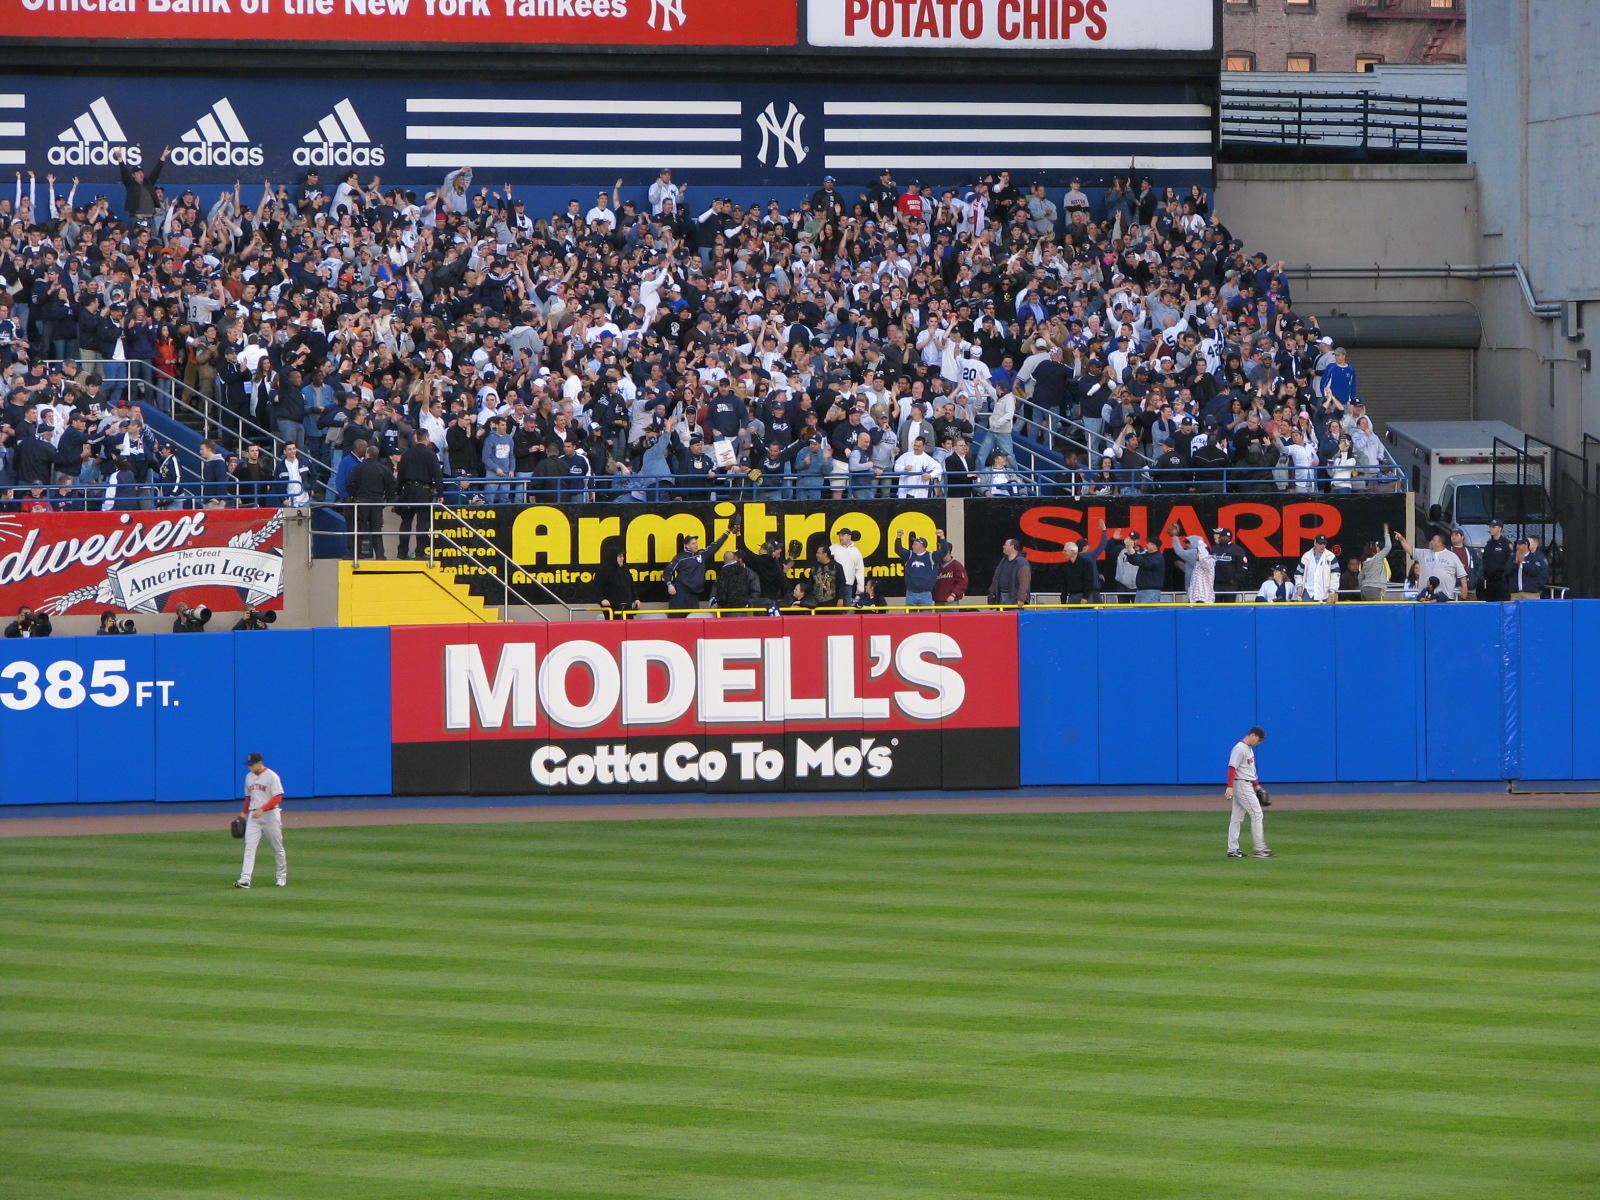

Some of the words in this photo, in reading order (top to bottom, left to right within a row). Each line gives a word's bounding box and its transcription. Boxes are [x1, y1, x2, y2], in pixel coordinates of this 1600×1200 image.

[345, 0, 410, 15] New
[424, 0, 491, 16] York
[503, 0, 628, 18] Yankees
[844, 0, 983, 39] POTATO
[997, 0, 1108, 41] CHIPS
[47, 141, 142, 166] adidas
[170, 141, 264, 166] adidas
[292, 141, 385, 166] adidas
[962, 367, 977, 381] 20
[434, 508, 496, 520] rmitron
[428, 526, 496, 539] rmitron
[512, 502, 938, 566] Armitron
[1018, 502, 1342, 564] SHARP
[177, 551, 193, 560] The
[196, 549, 221, 558] Great
[129, 562, 215, 597] American
[221, 559, 275, 584] Lager
[512, 569, 596, 584] Armitro
[0, 659, 130, 711] 385
[136, 680, 180, 707] FT.
[445, 631, 967, 730] MODELL'S
[530, 744, 658, 787] Gotta
[663, 741, 728, 783] Go
[731, 740, 784, 782] To
[796, 736, 893, 780] Mo's
